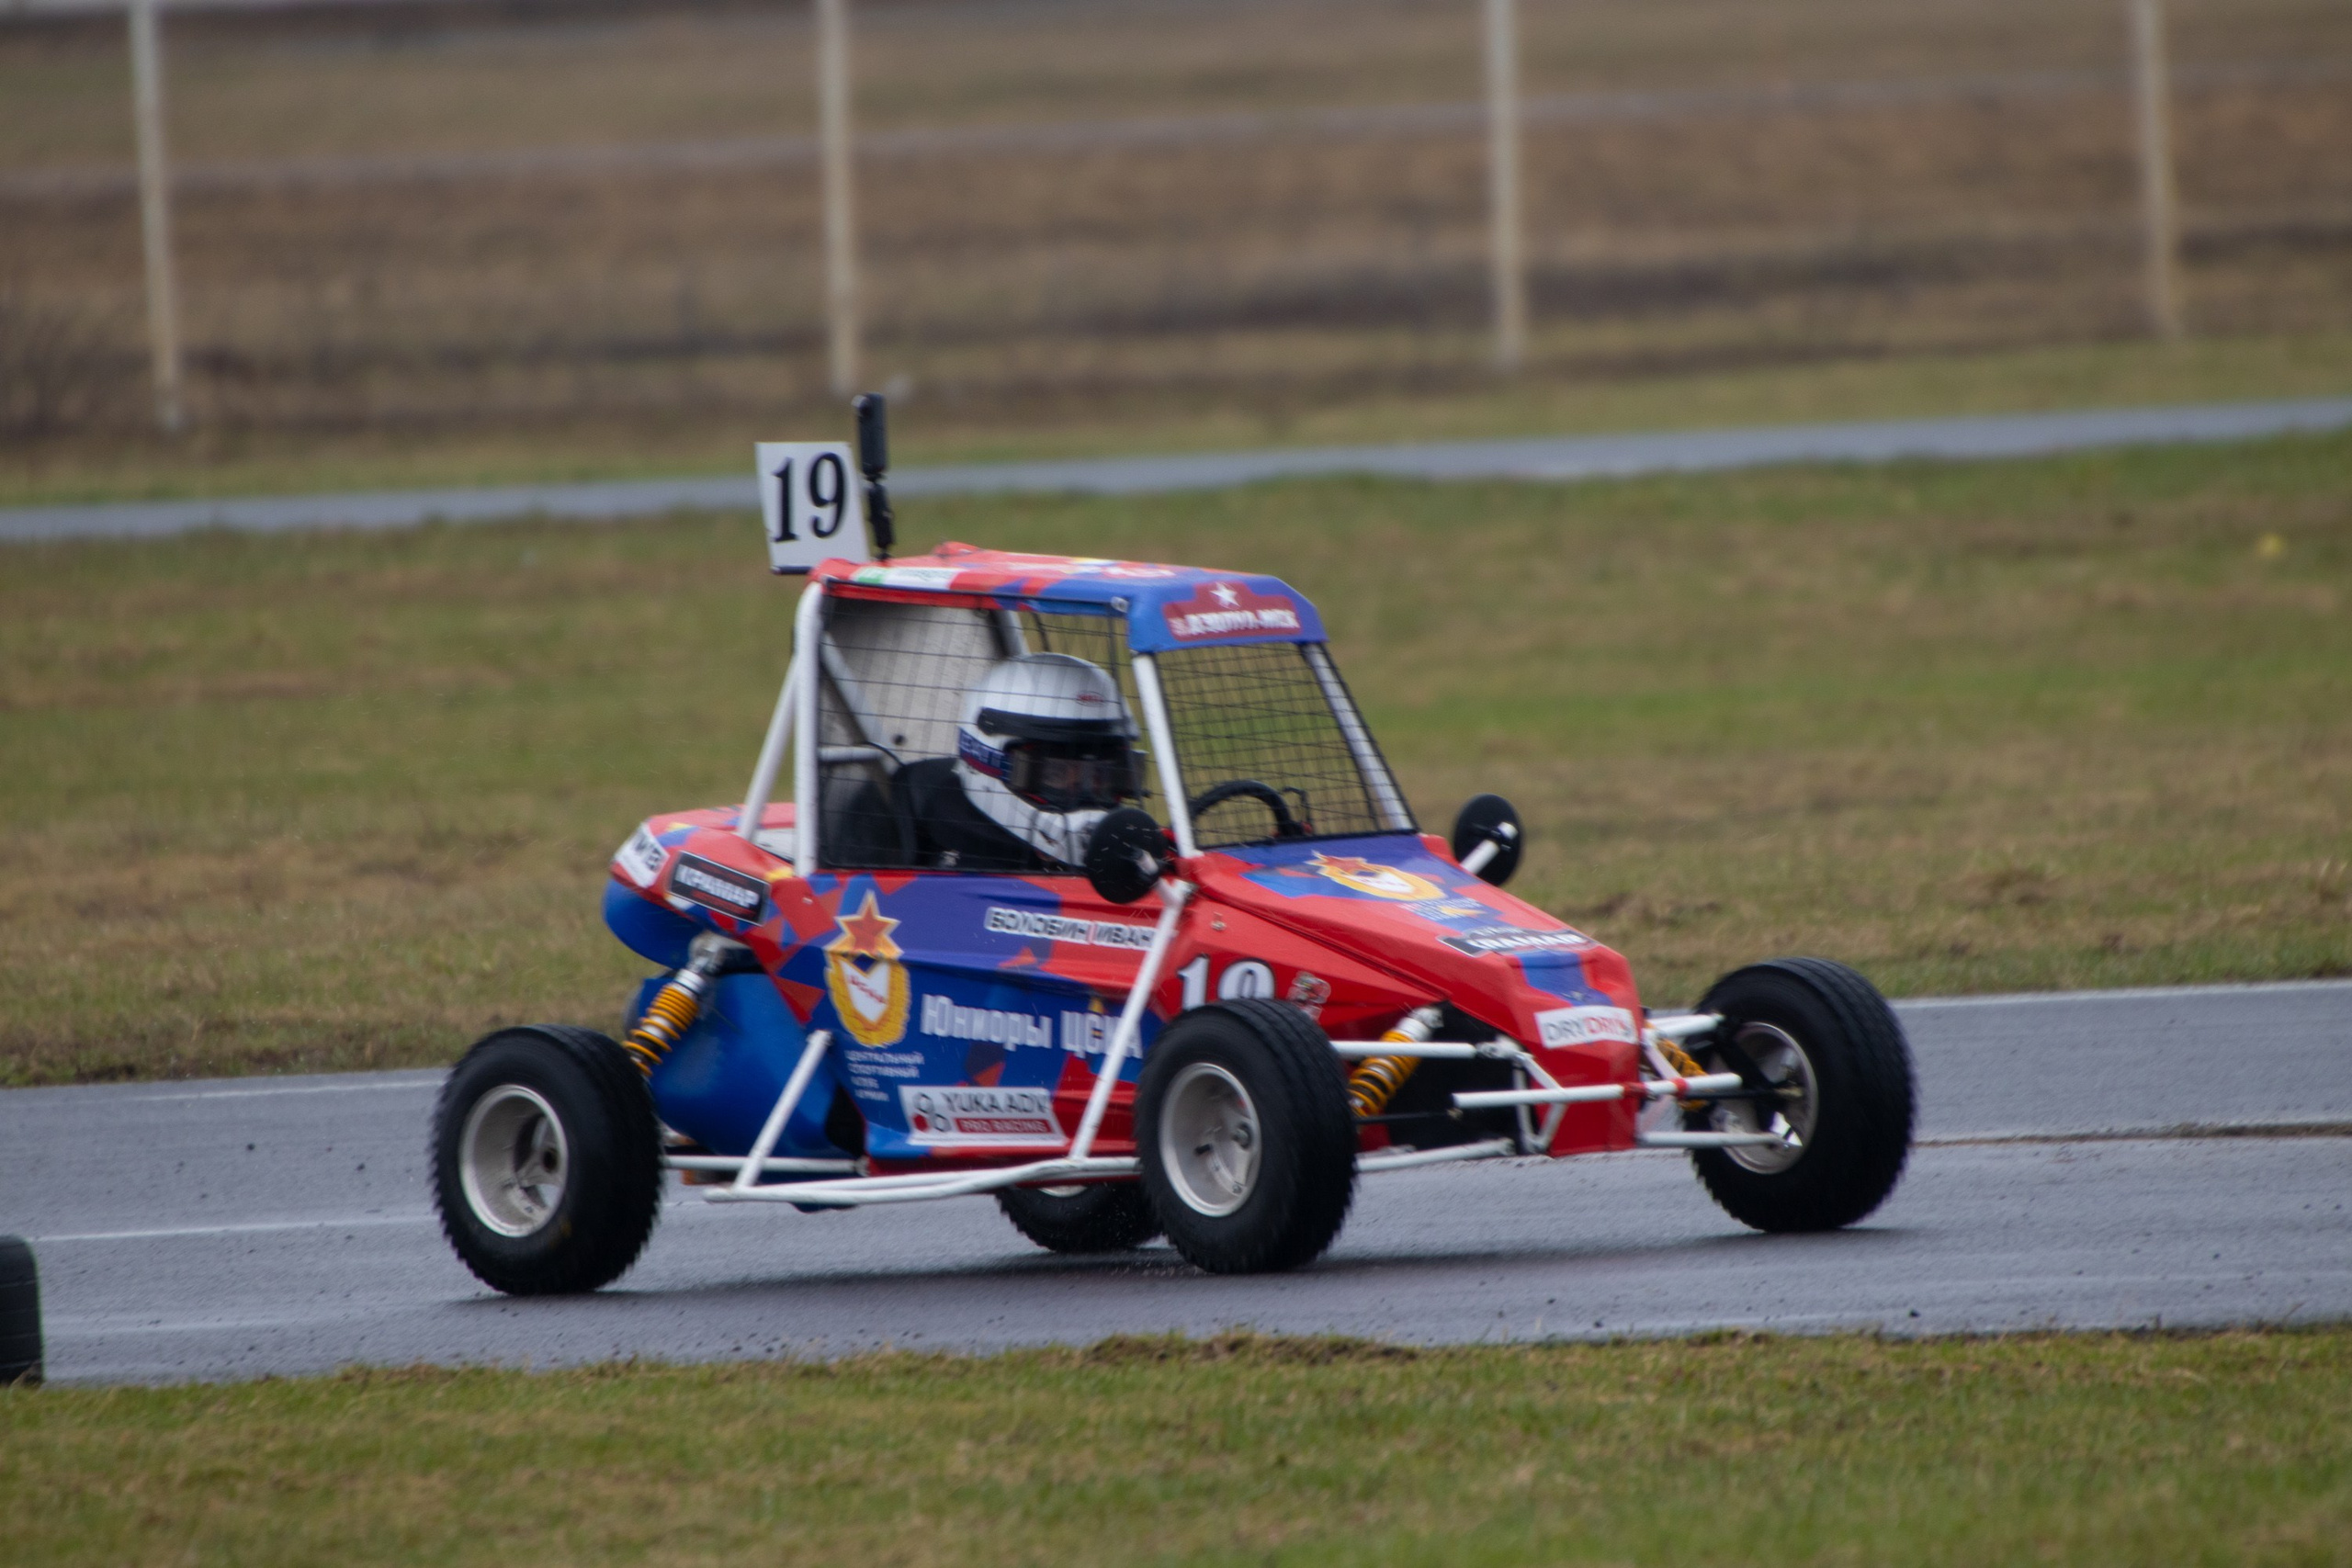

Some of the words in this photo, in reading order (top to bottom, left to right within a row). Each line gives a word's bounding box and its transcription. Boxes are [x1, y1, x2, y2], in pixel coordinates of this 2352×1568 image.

[771, 452, 845, 542] 19
[921, 994, 1052, 1051] Юниоры
[941, 1092, 1003, 1113] YUKA
[960, 1119, 991, 1133] PRO
[991, 1119, 1047, 1134] RACING
